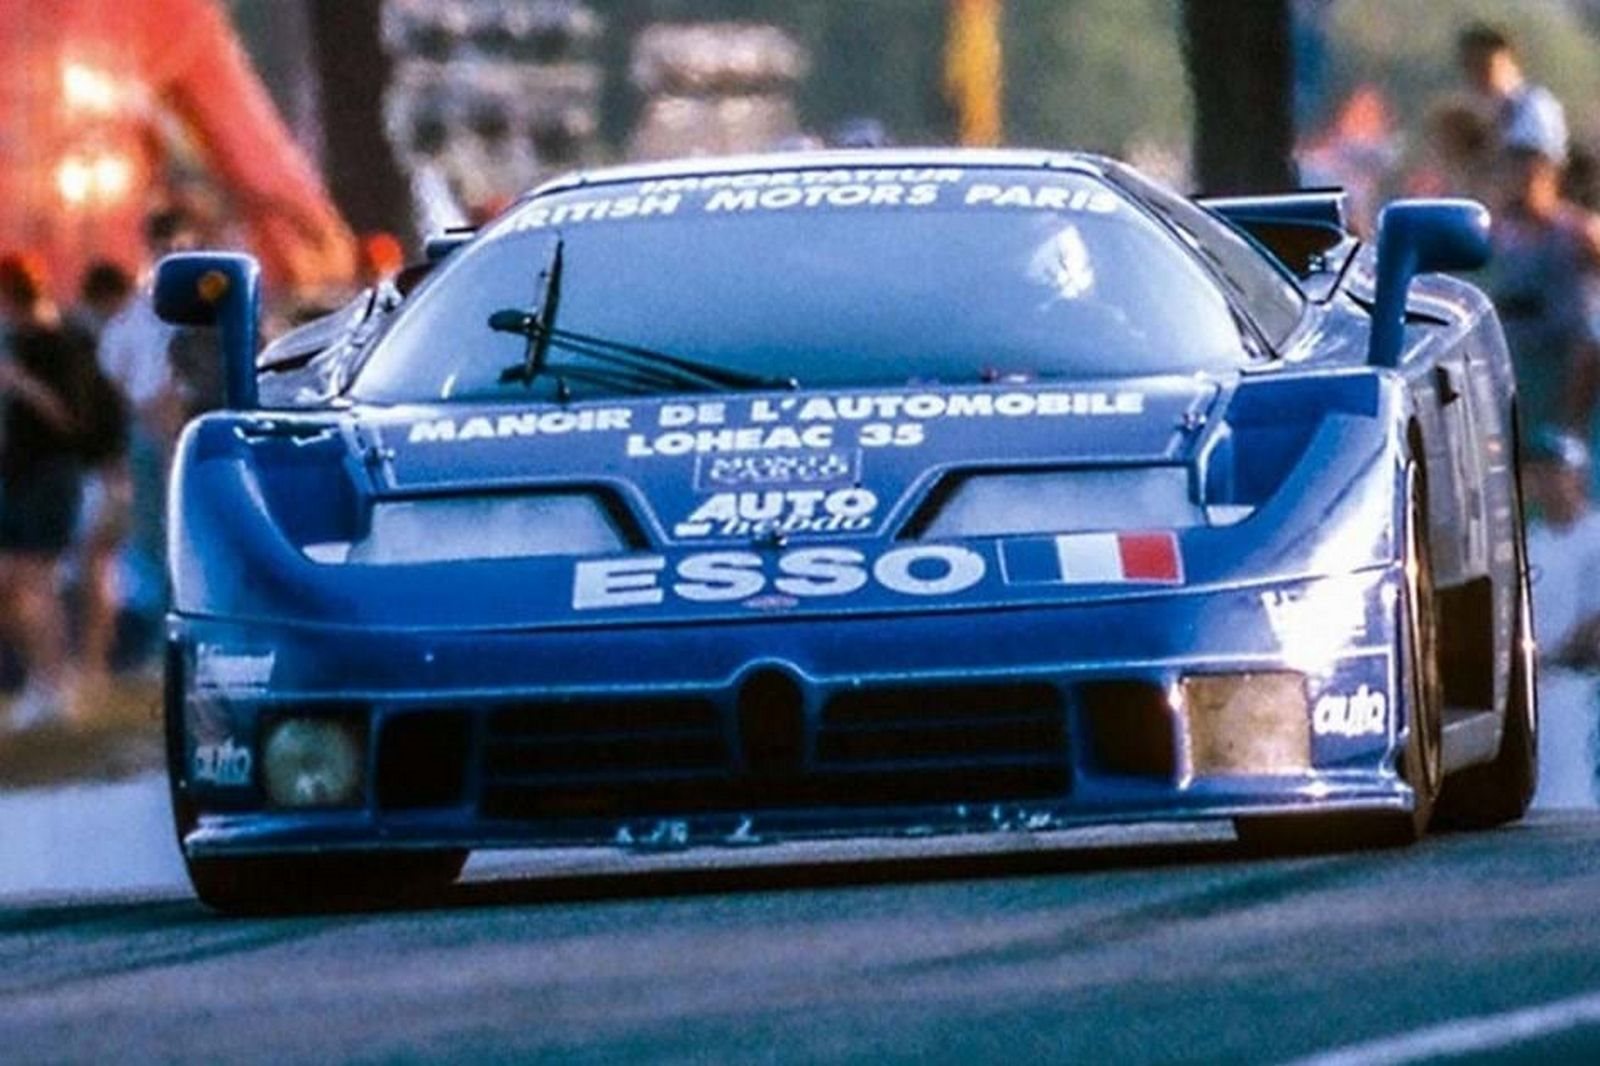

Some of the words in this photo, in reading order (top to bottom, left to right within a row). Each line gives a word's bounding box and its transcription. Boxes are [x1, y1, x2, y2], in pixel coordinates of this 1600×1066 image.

[705, 185, 939, 211] MOTORS
[965, 184, 1118, 213] PARIS
[409, 408, 632, 442] MANOIR
[659, 402, 726, 426] DE
[751, 393, 1145, 422] L'AUTOMOBILE
[627, 425, 833, 457] LOHEAC
[858, 424, 924, 446] 35
[688, 489, 878, 522] AUTO
[572, 544, 986, 610] ESSO
[1313, 685, 1386, 736] auto
